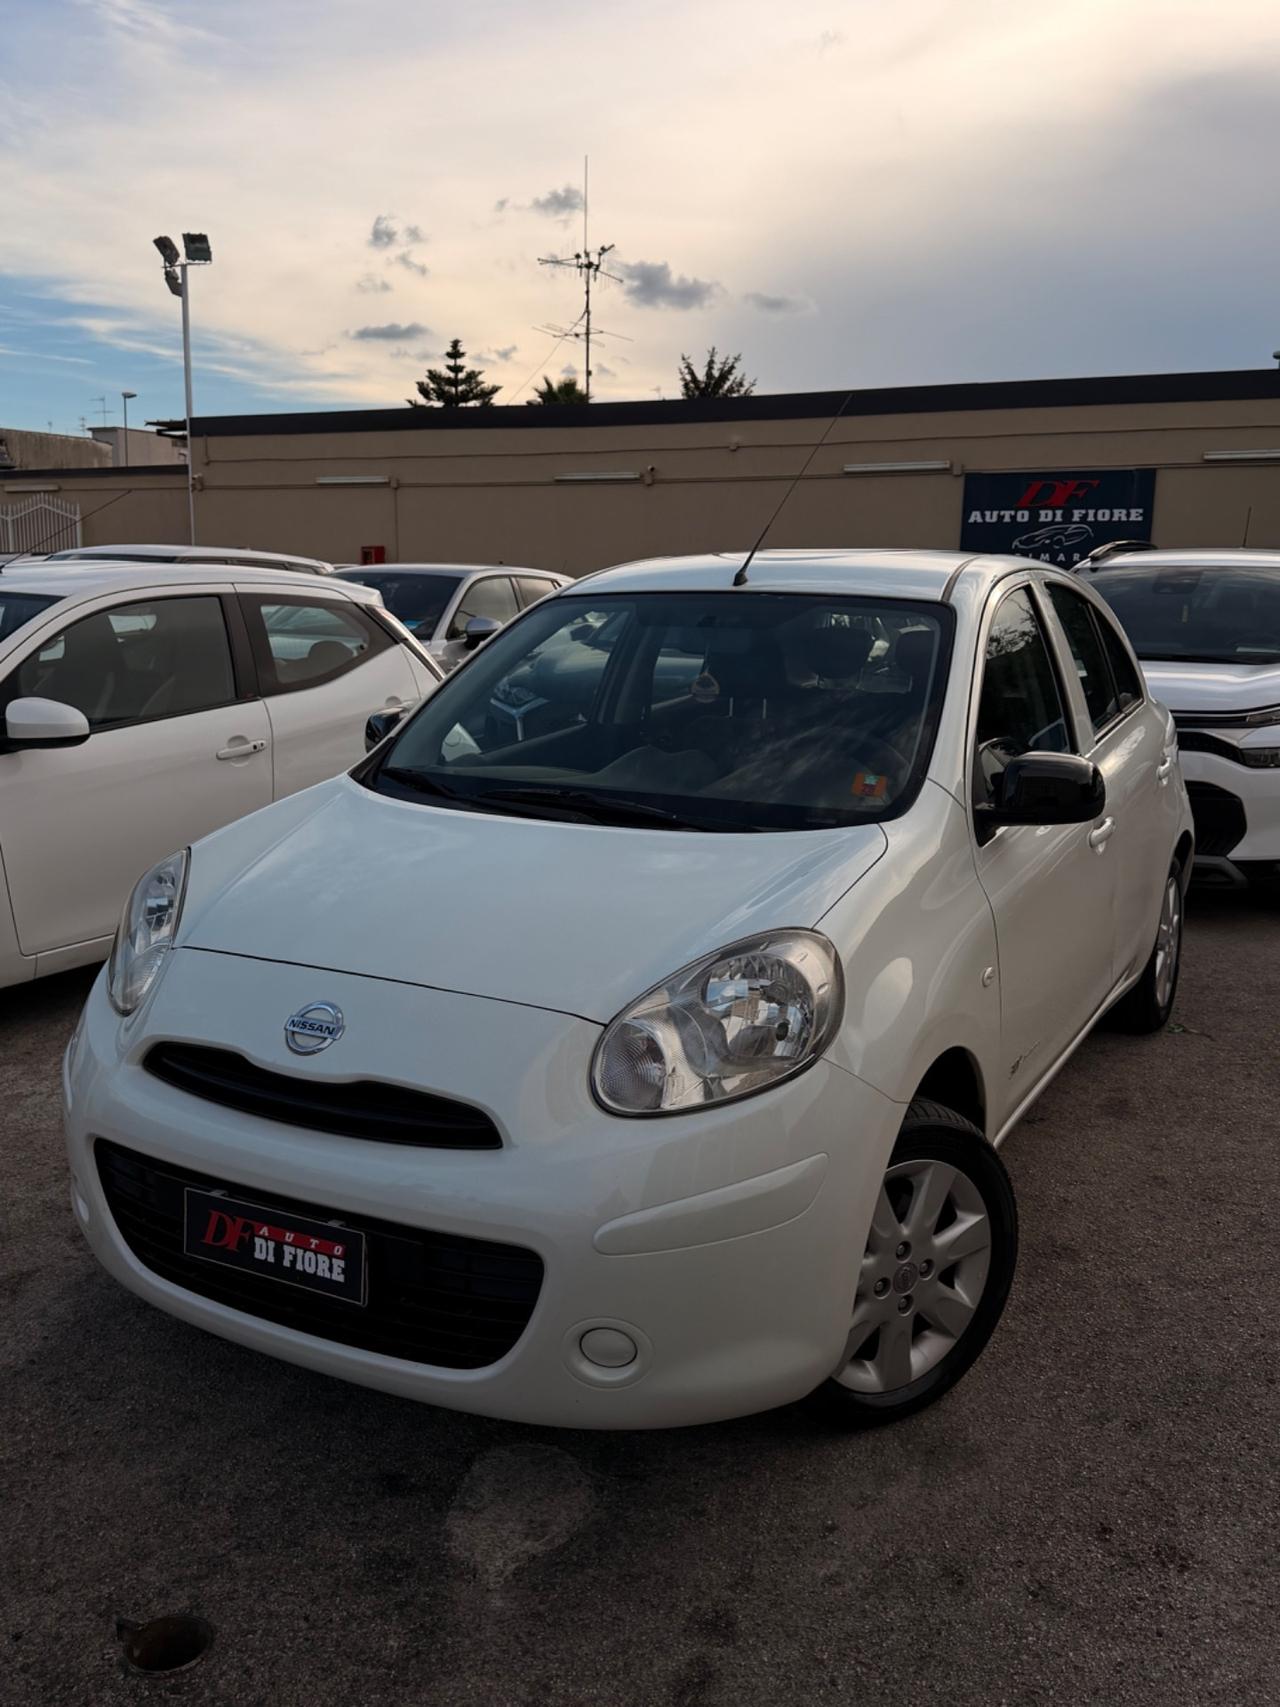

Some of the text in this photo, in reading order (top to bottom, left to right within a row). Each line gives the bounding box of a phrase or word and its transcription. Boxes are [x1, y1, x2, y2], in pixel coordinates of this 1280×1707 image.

[1014, 480, 1101, 507] DF
[968, 508, 1145, 523] AUTO DI FIORE
[288, 1019, 336, 1035] NISSAN
[202, 1209, 257, 1251] DF
[259, 1226, 343, 1256] AUTO
[254, 1236, 345, 1283] DI FIORE
